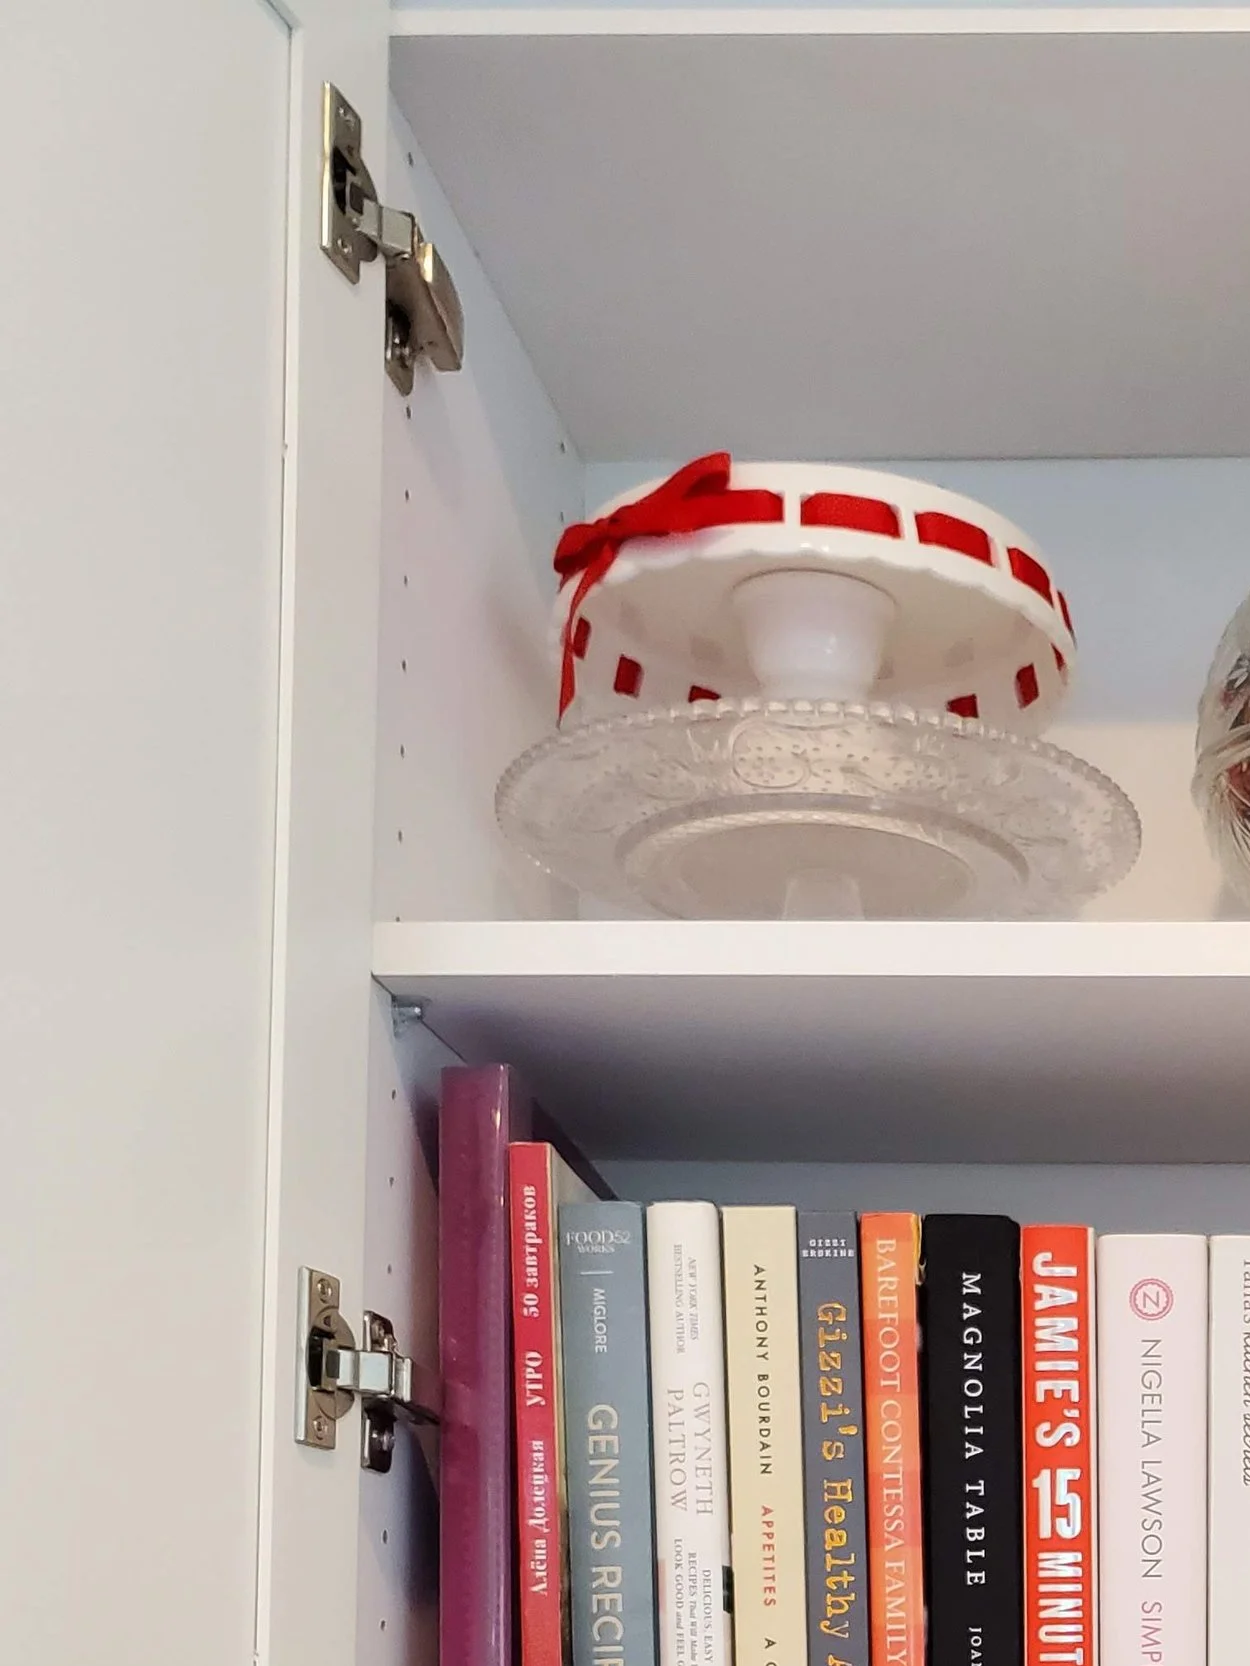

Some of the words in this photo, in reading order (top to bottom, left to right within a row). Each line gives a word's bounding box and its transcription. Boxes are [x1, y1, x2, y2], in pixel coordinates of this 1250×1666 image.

[522, 1185, 543, 1289] завтраков
[523, 1296, 540, 1318] 50
[593, 1288, 608, 1354] MIGLORE
[754, 1264, 769, 1361] ANTHONY
[876, 1238, 901, 1393] BAREFOOT
[1032, 1251, 1081, 1448] JAMIE'S
[525, 1350, 546, 1407] УТРО
[817, 1302, 858, 1461] Gizzi's
[962, 1272, 984, 1460] MAGNOLIA
[1141, 1339, 1163, 1448] NIGELLA
[667, 1388, 688, 1512] PALTROW
[692, 1381, 714, 1517] GWYNETH
[756, 1374, 773, 1475] BOURDAIN
[528, 1440, 550, 1534] Долецкая
[587, 1404, 622, 1551] GENIUS
[879, 1402, 905, 1552] CONTESSA
[1032, 1467, 1082, 1540] 15
[1141, 1460, 1163, 1578] LAWSON
[530, 1537, 548, 1597] Алёна
[688, 1552, 697, 1597] RECIPES
[761, 1505, 777, 1607] APPETITES
[820, 1478, 856, 1639] Healthy
[966, 1480, 986, 1586] TABLE
[674, 1574, 685, 1609] GOOD
[703, 1635, 714, 1663] EASY
[764, 1638, 777, 1649] A
